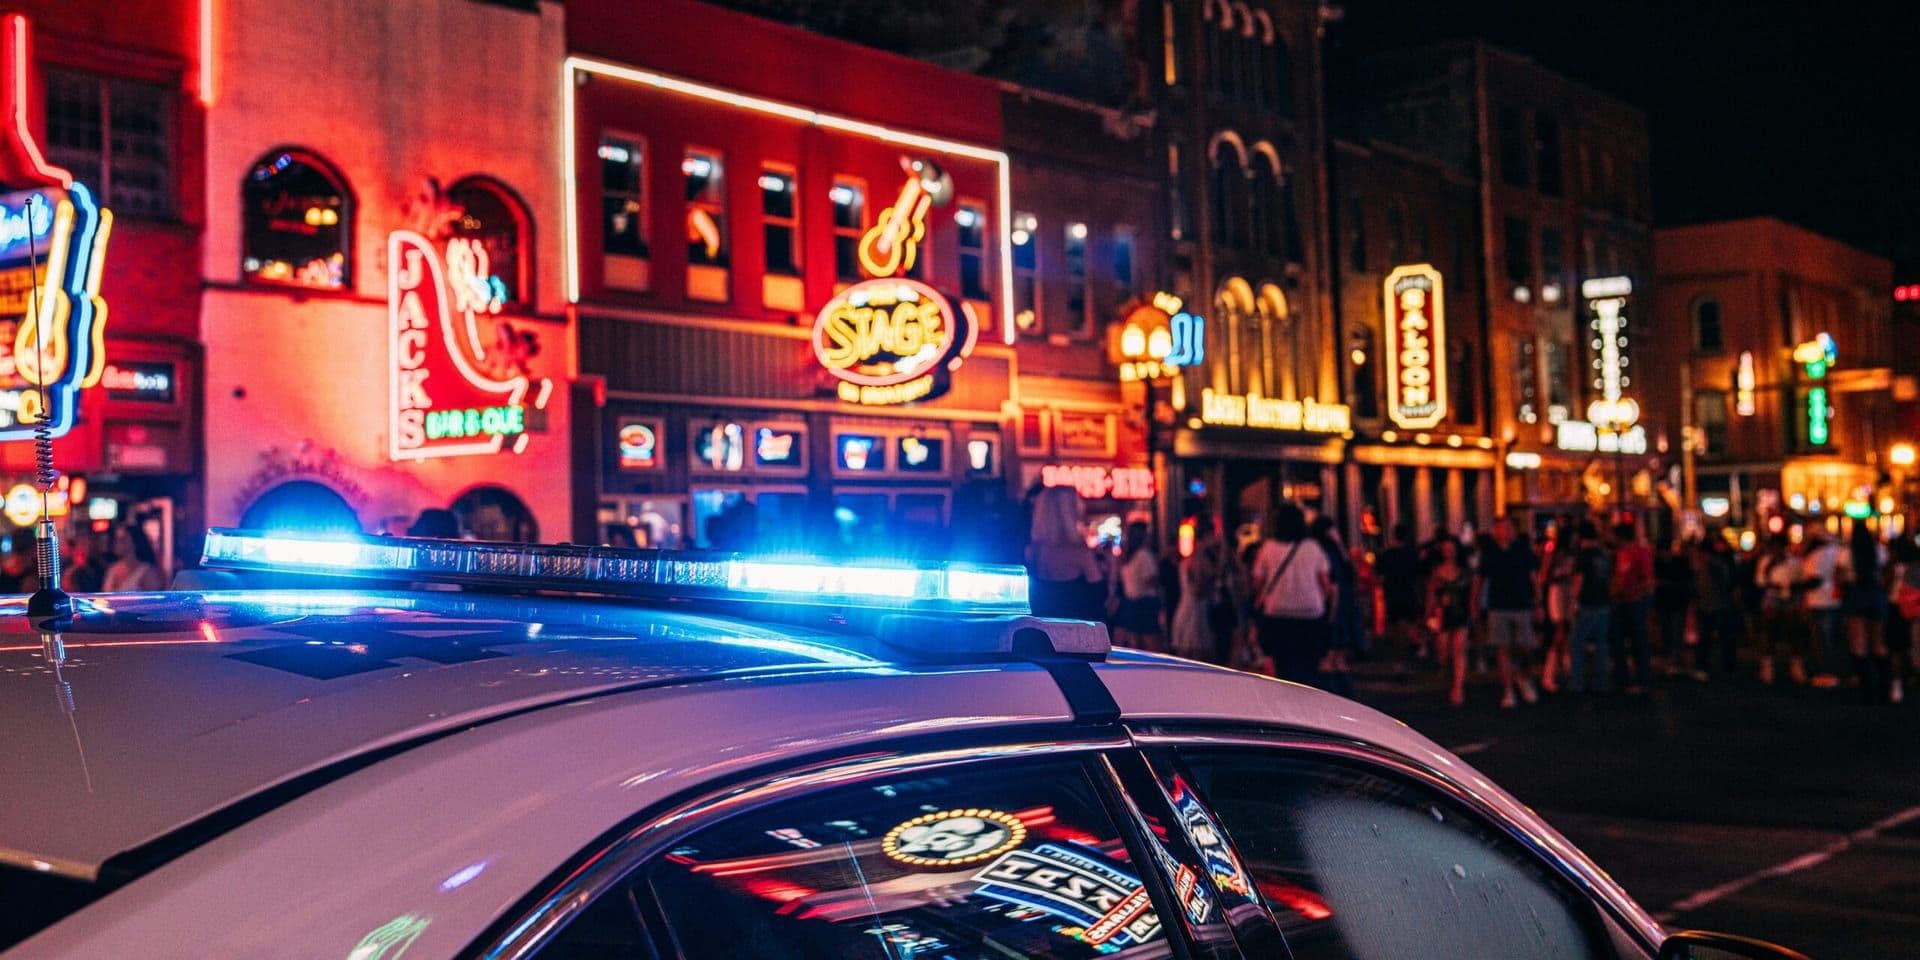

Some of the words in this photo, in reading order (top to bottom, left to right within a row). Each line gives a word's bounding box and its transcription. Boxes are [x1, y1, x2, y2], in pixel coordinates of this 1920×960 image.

[399, 249, 432, 448] JACKS
[823, 301, 945, 368] STAGE
[1400, 288, 1430, 407] SALOON
